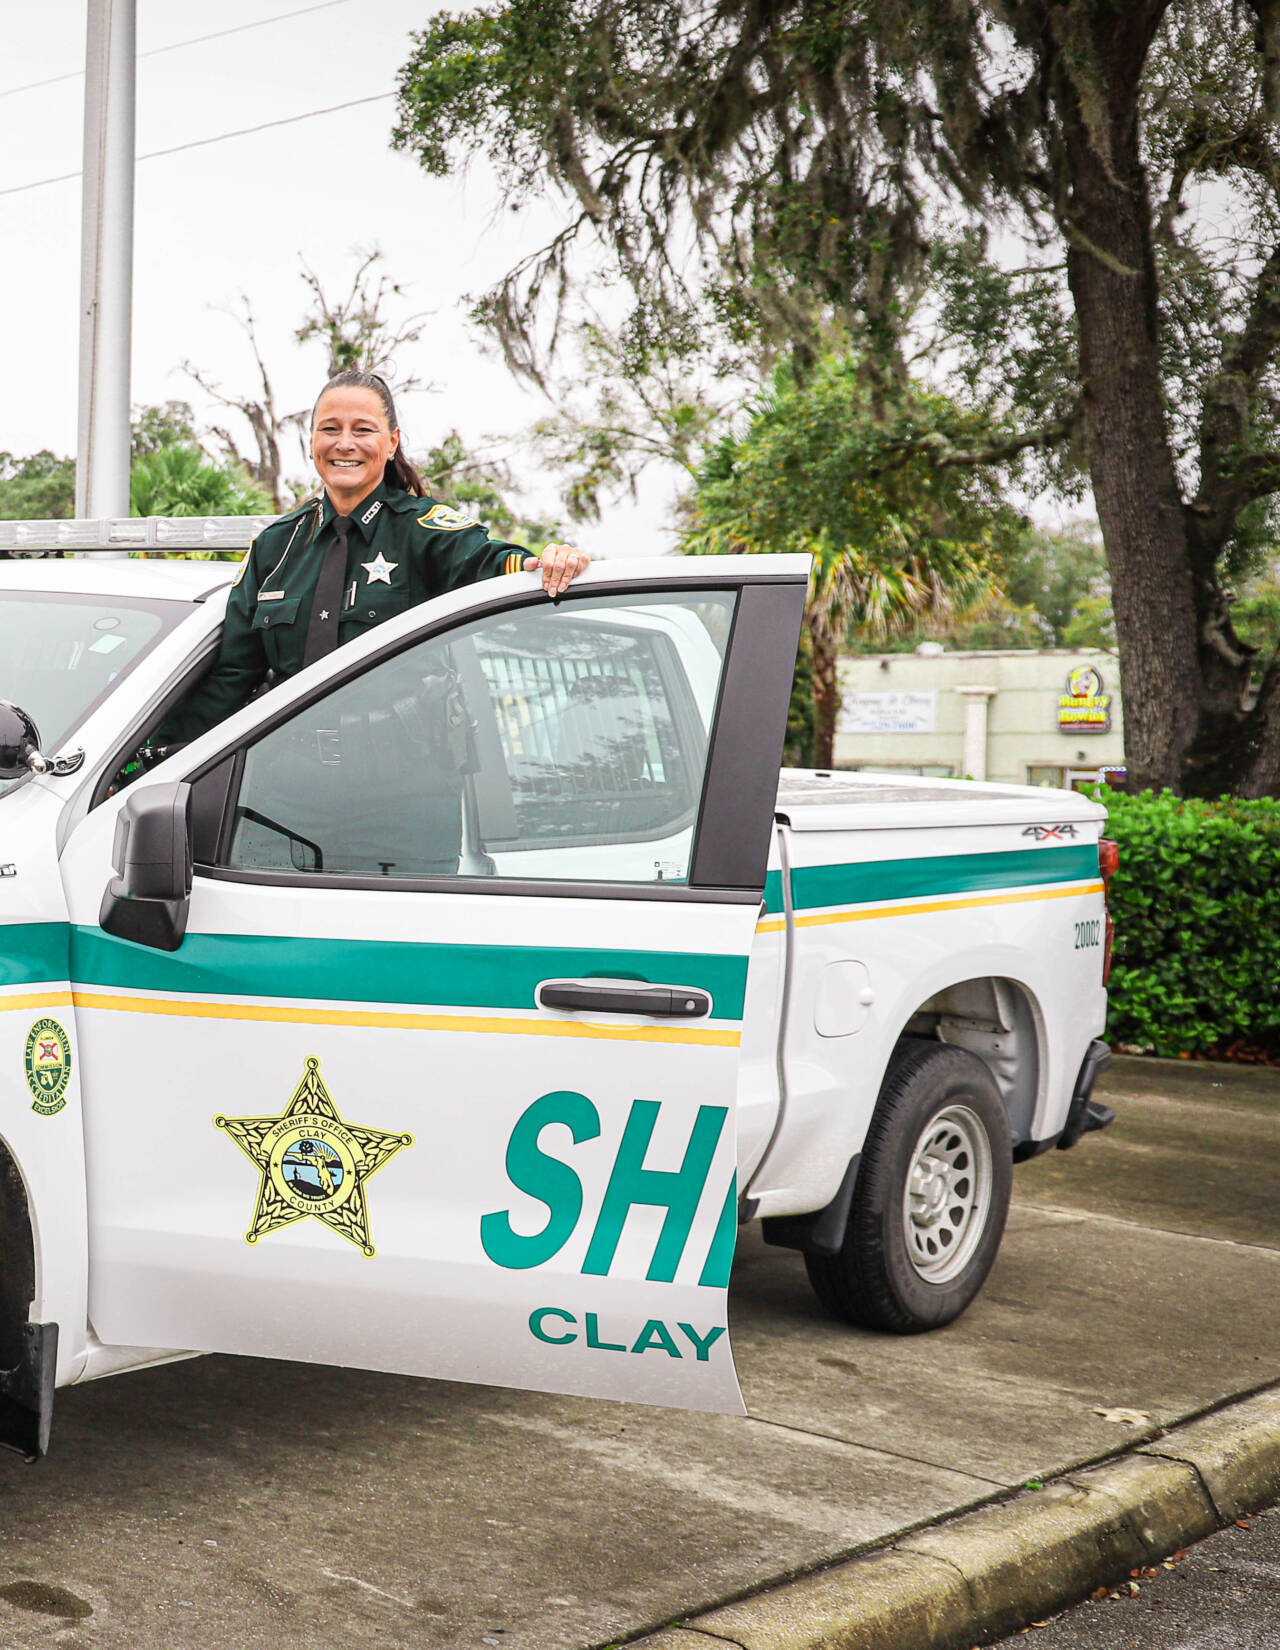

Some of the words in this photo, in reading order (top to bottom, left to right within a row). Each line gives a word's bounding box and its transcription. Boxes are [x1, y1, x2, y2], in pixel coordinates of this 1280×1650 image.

[1074, 920, 1100, 950] 20002
[272, 1117, 318, 1138] SHERIFF'S
[321, 1119, 353, 1145] OFFICE
[298, 1130, 327, 1140] CLAY
[289, 1196, 335, 1212] COUNTY
[528, 1307, 727, 1362] CLAY
